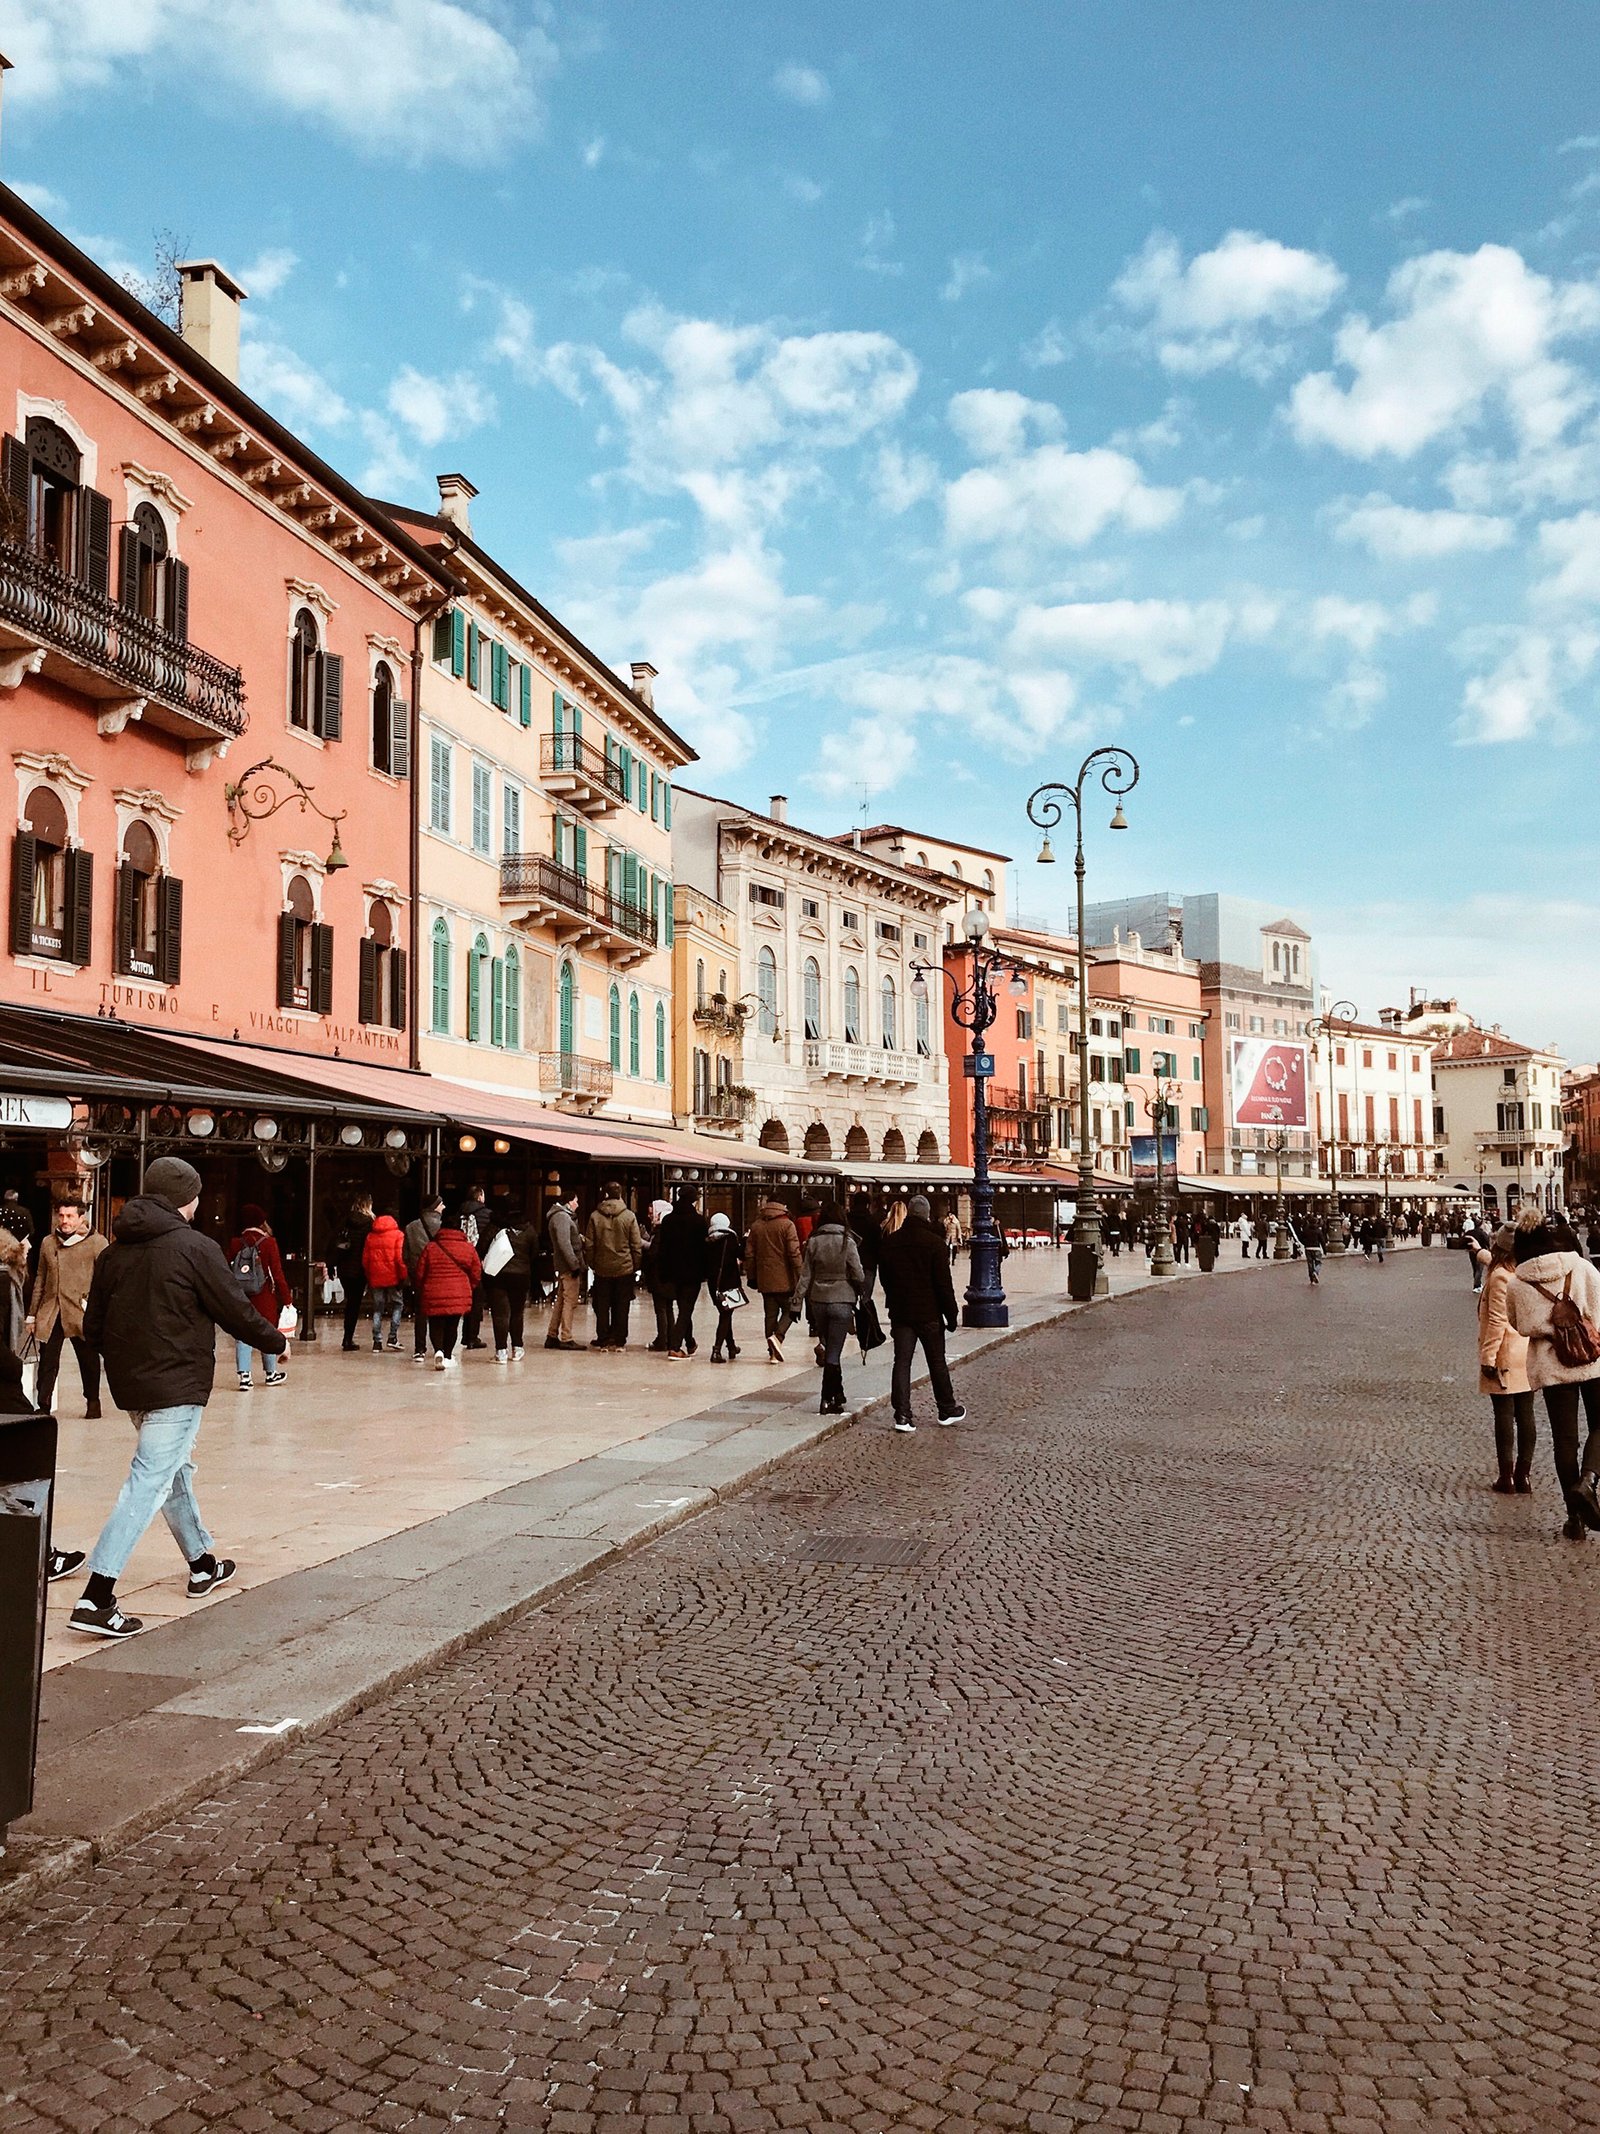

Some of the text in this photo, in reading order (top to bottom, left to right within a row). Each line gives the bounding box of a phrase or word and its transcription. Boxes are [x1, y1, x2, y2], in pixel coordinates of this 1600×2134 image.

[32, 970, 400, 1051] IL TURISMO E VIAGGI VALPANTENA
[107, 1613, 126, 1630] N
